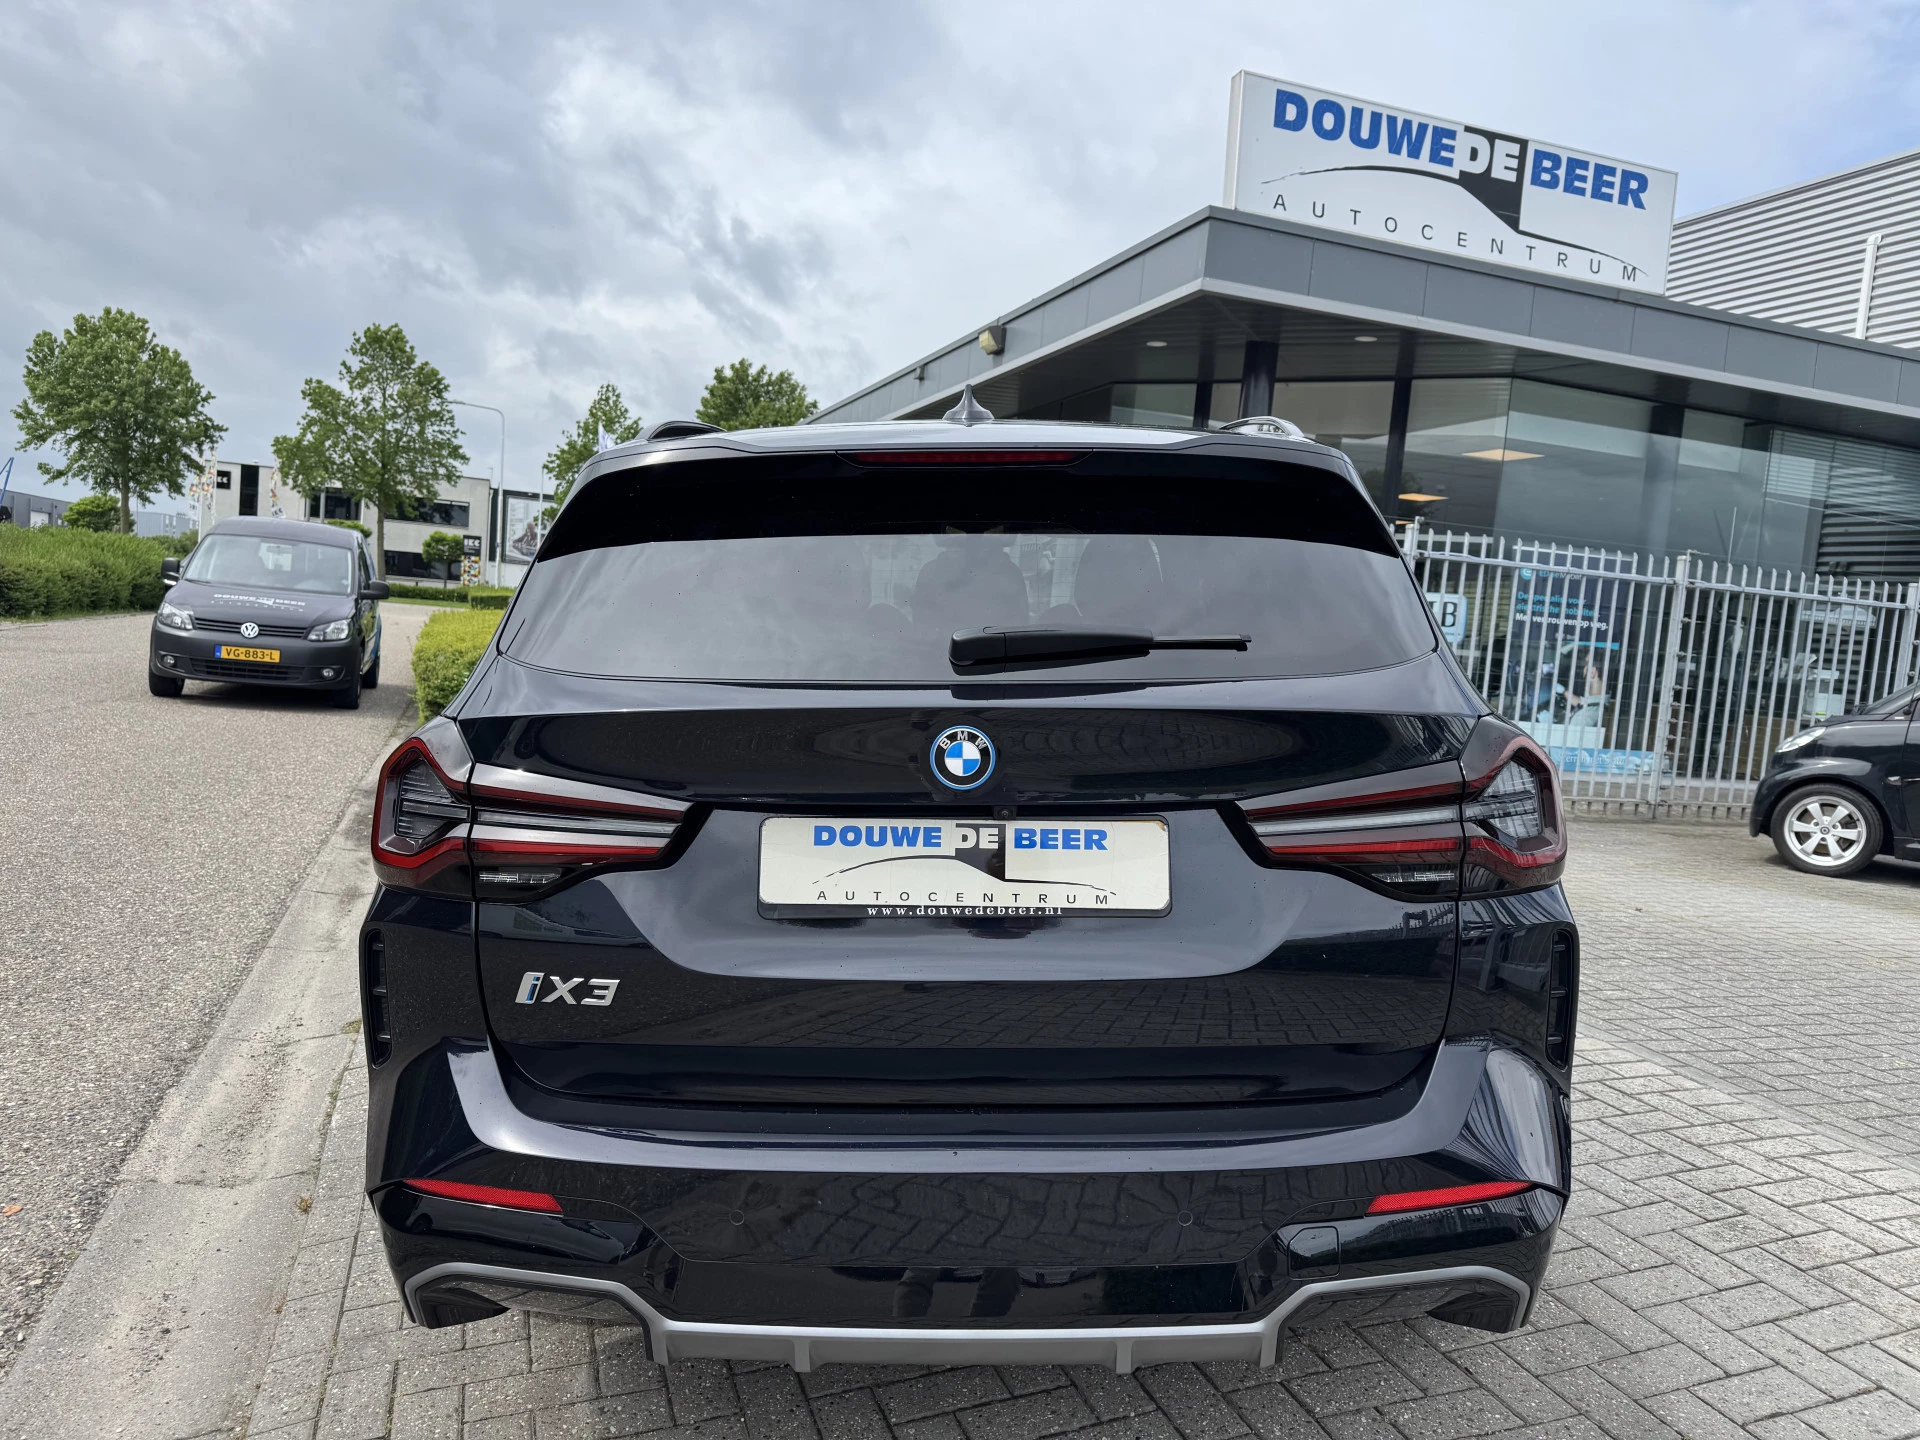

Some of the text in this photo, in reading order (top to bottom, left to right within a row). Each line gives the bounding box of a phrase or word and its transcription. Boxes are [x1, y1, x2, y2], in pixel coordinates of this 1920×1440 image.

[1273, 88, 1649, 211] DOUWE DE BEER
[1273, 194, 1637, 282] AUTOCENTRUM
[1530, 594, 1567, 603] pecalis
[1516, 602, 1560, 614] eletrishe
[1515, 612, 1529, 621] Me
[226, 647, 276, 661] VG-883-L
[939, 730, 988, 750] BMW
[813, 825, 1109, 851] DOUWE DE BEER
[817, 890, 1109, 906] AUTOCENTRUM
[866, 905, 1063, 917] www.douwedebeer.nl
